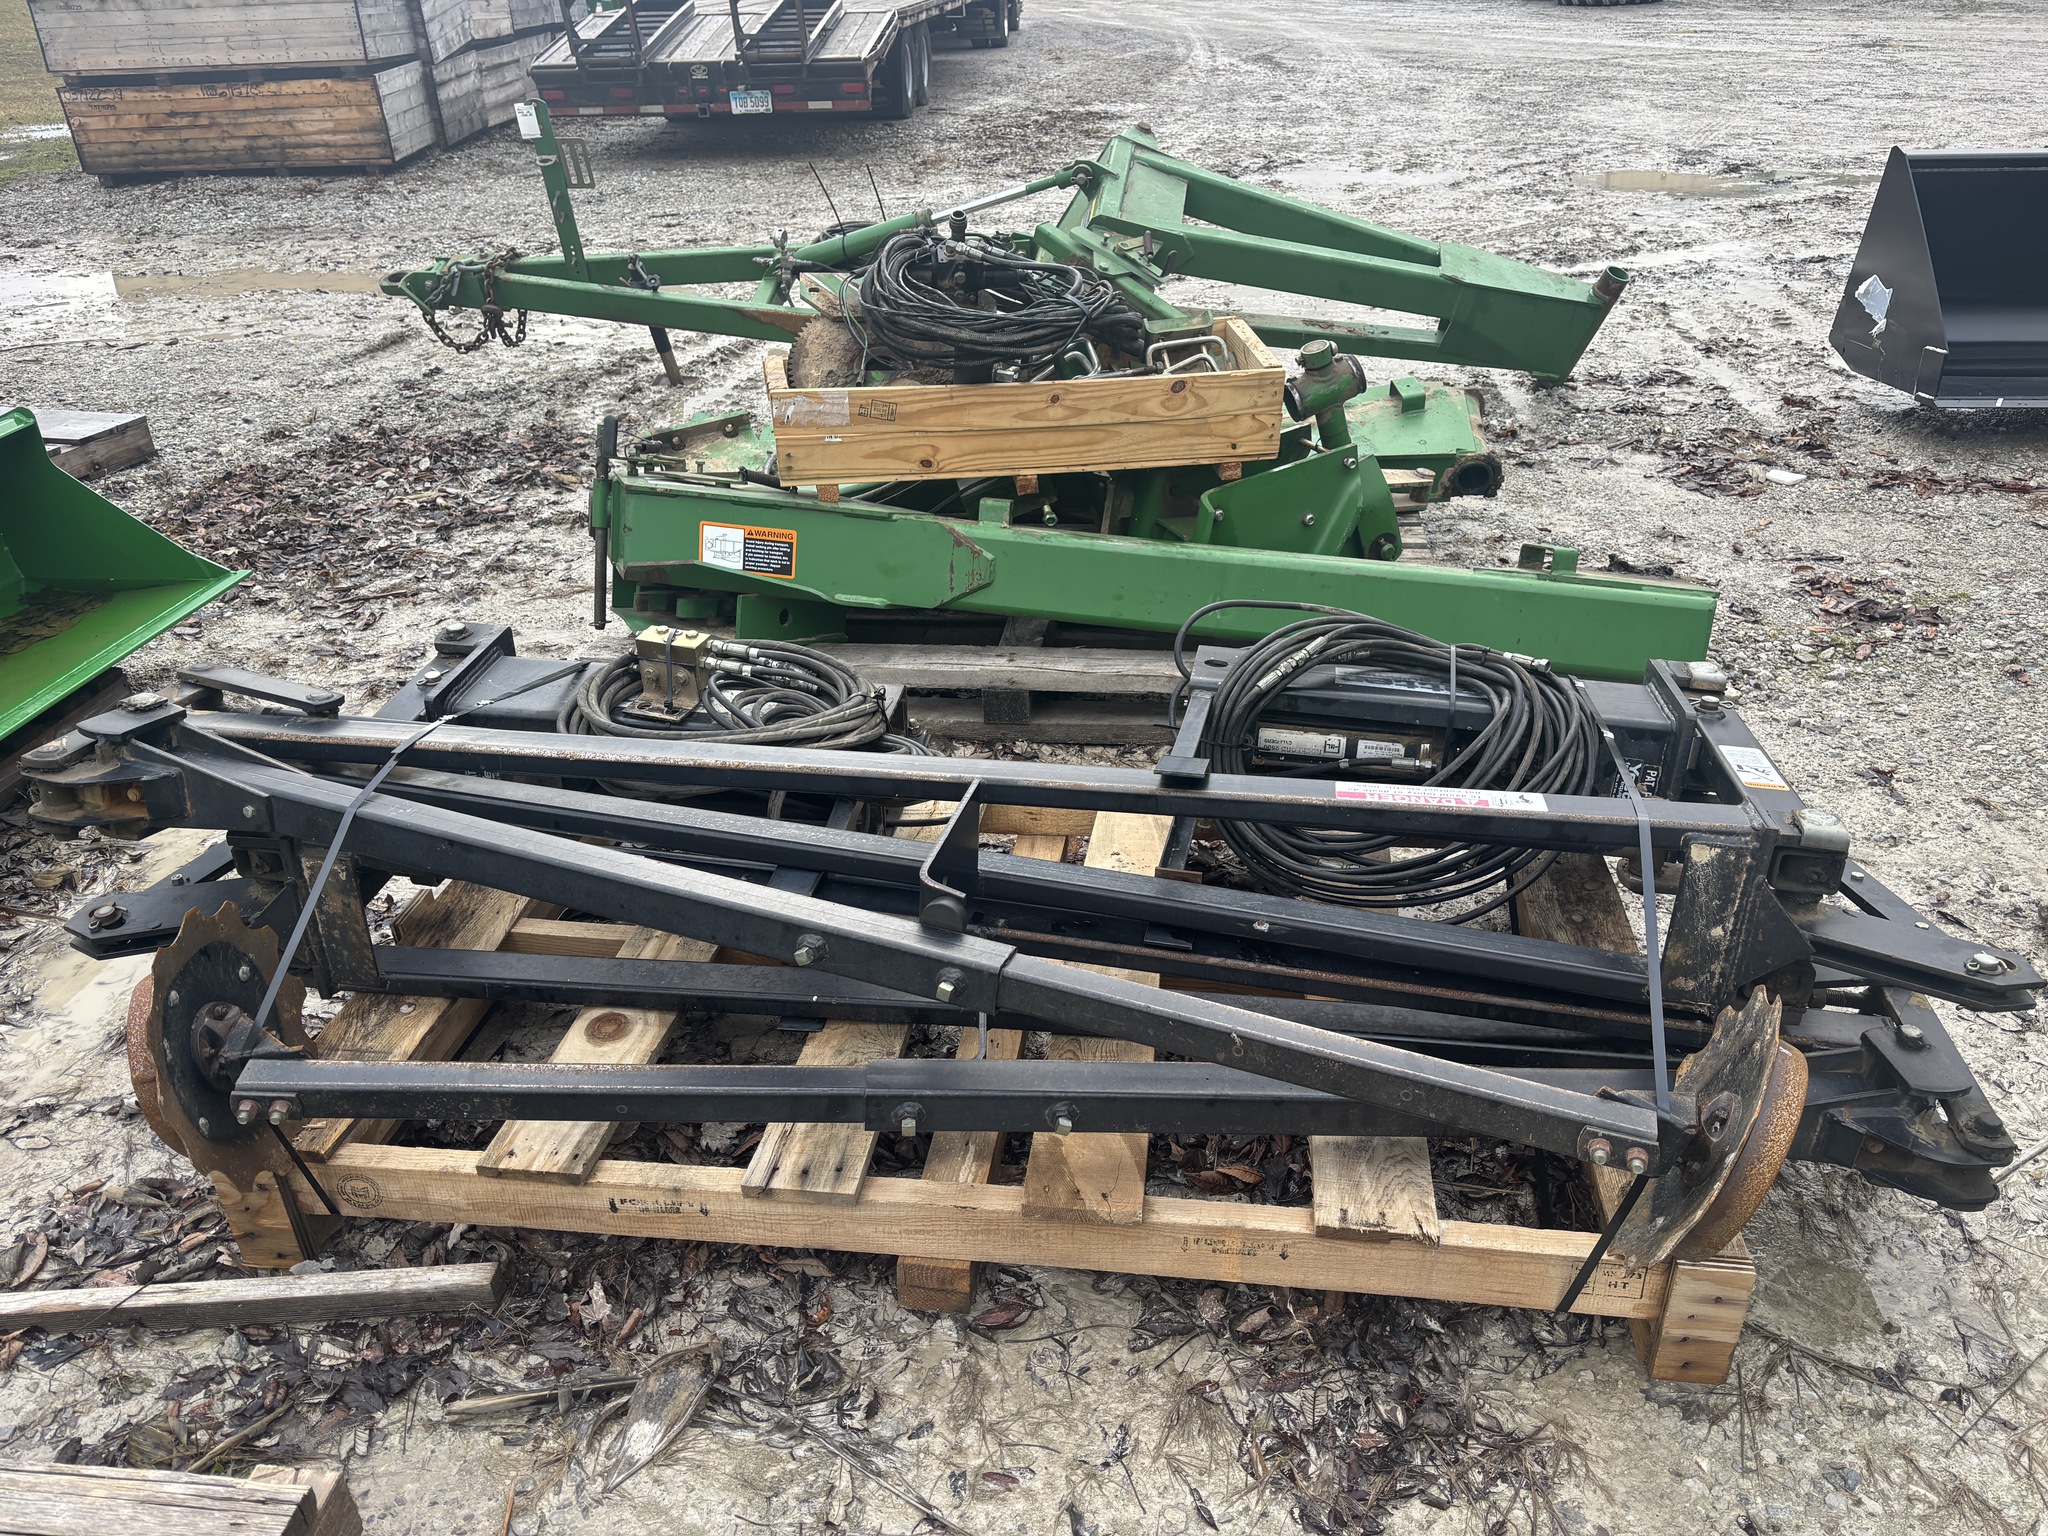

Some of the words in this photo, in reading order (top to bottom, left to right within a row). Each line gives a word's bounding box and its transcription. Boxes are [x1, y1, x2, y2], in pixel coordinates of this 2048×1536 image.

[749, 96, 770, 108] 5099
[754, 530, 794, 540] WARNING
[1645, 769, 1658, 787] PAT
[1364, 793, 1457, 804] DANGER
[1607, 1280, 1630, 1289] HT
